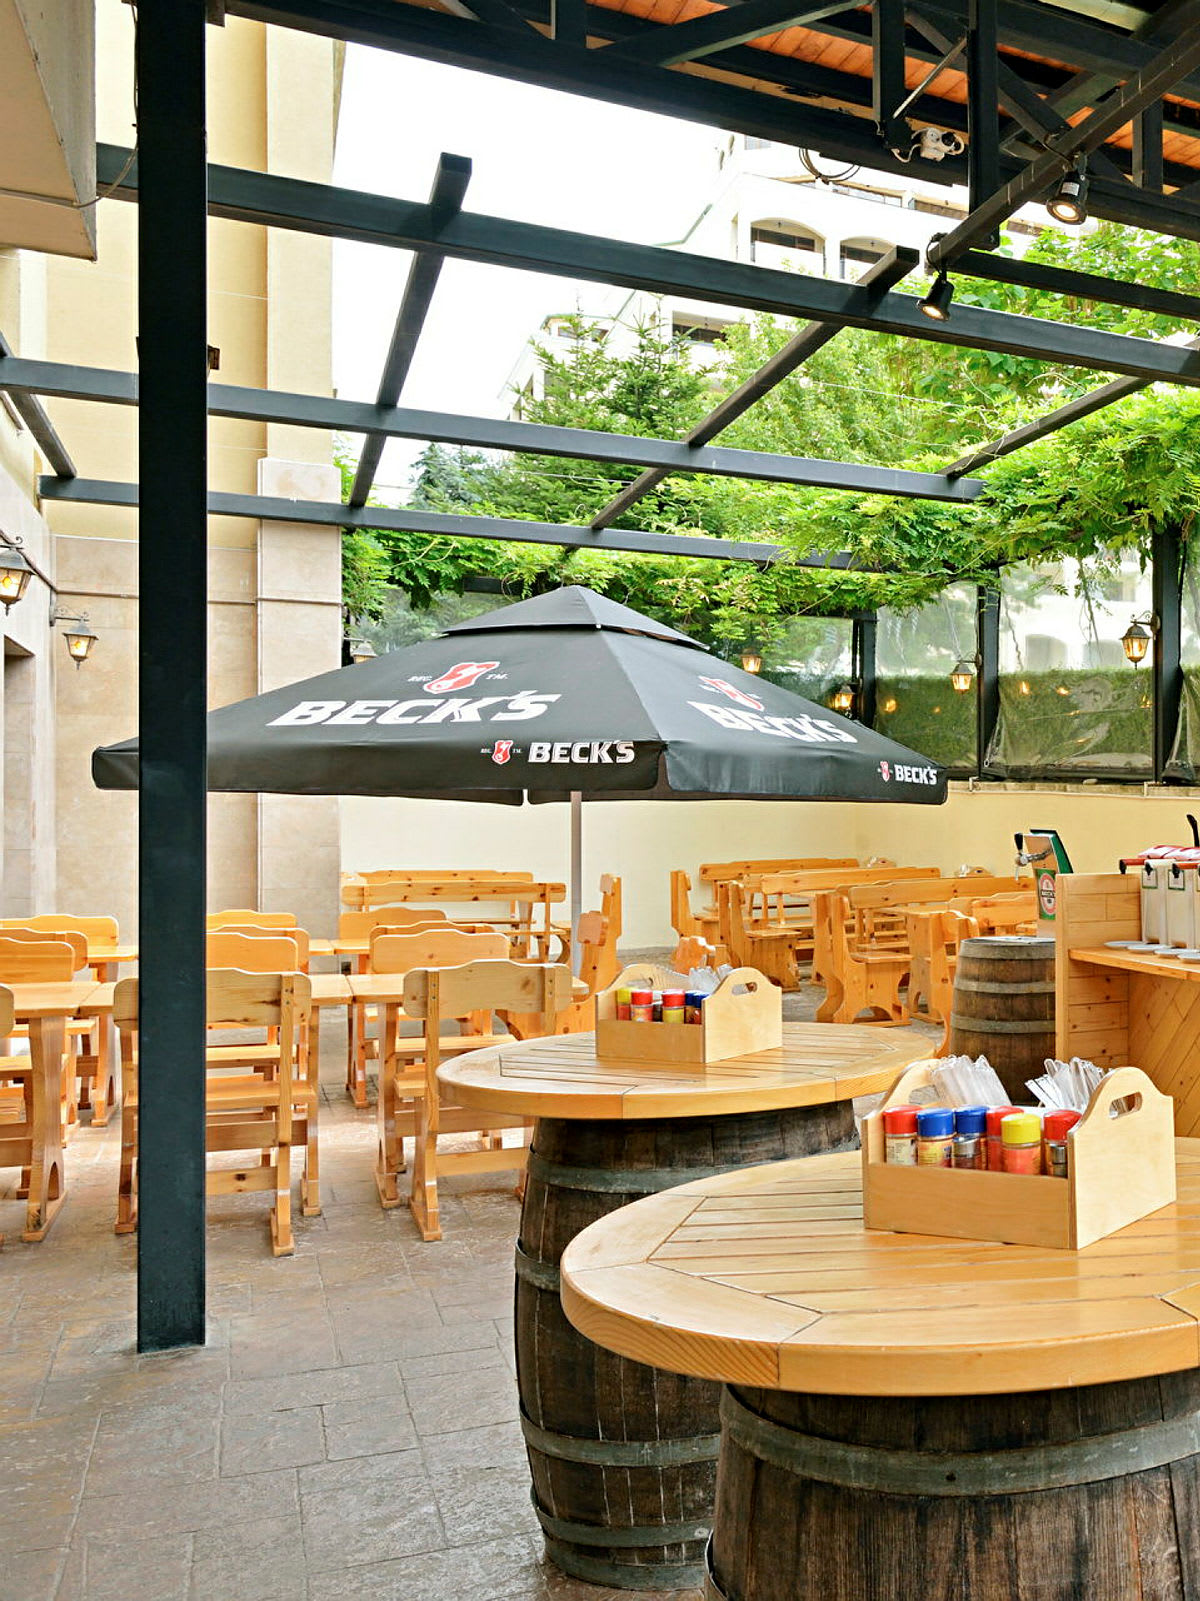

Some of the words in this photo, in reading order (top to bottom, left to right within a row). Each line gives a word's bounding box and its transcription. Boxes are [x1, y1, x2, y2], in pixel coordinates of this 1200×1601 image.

[266, 690, 562, 726] BECK'S
[687, 700, 858, 744] BECK'S
[528, 740, 635, 764] BECK'S
[894, 764, 938, 785] BECK'S
